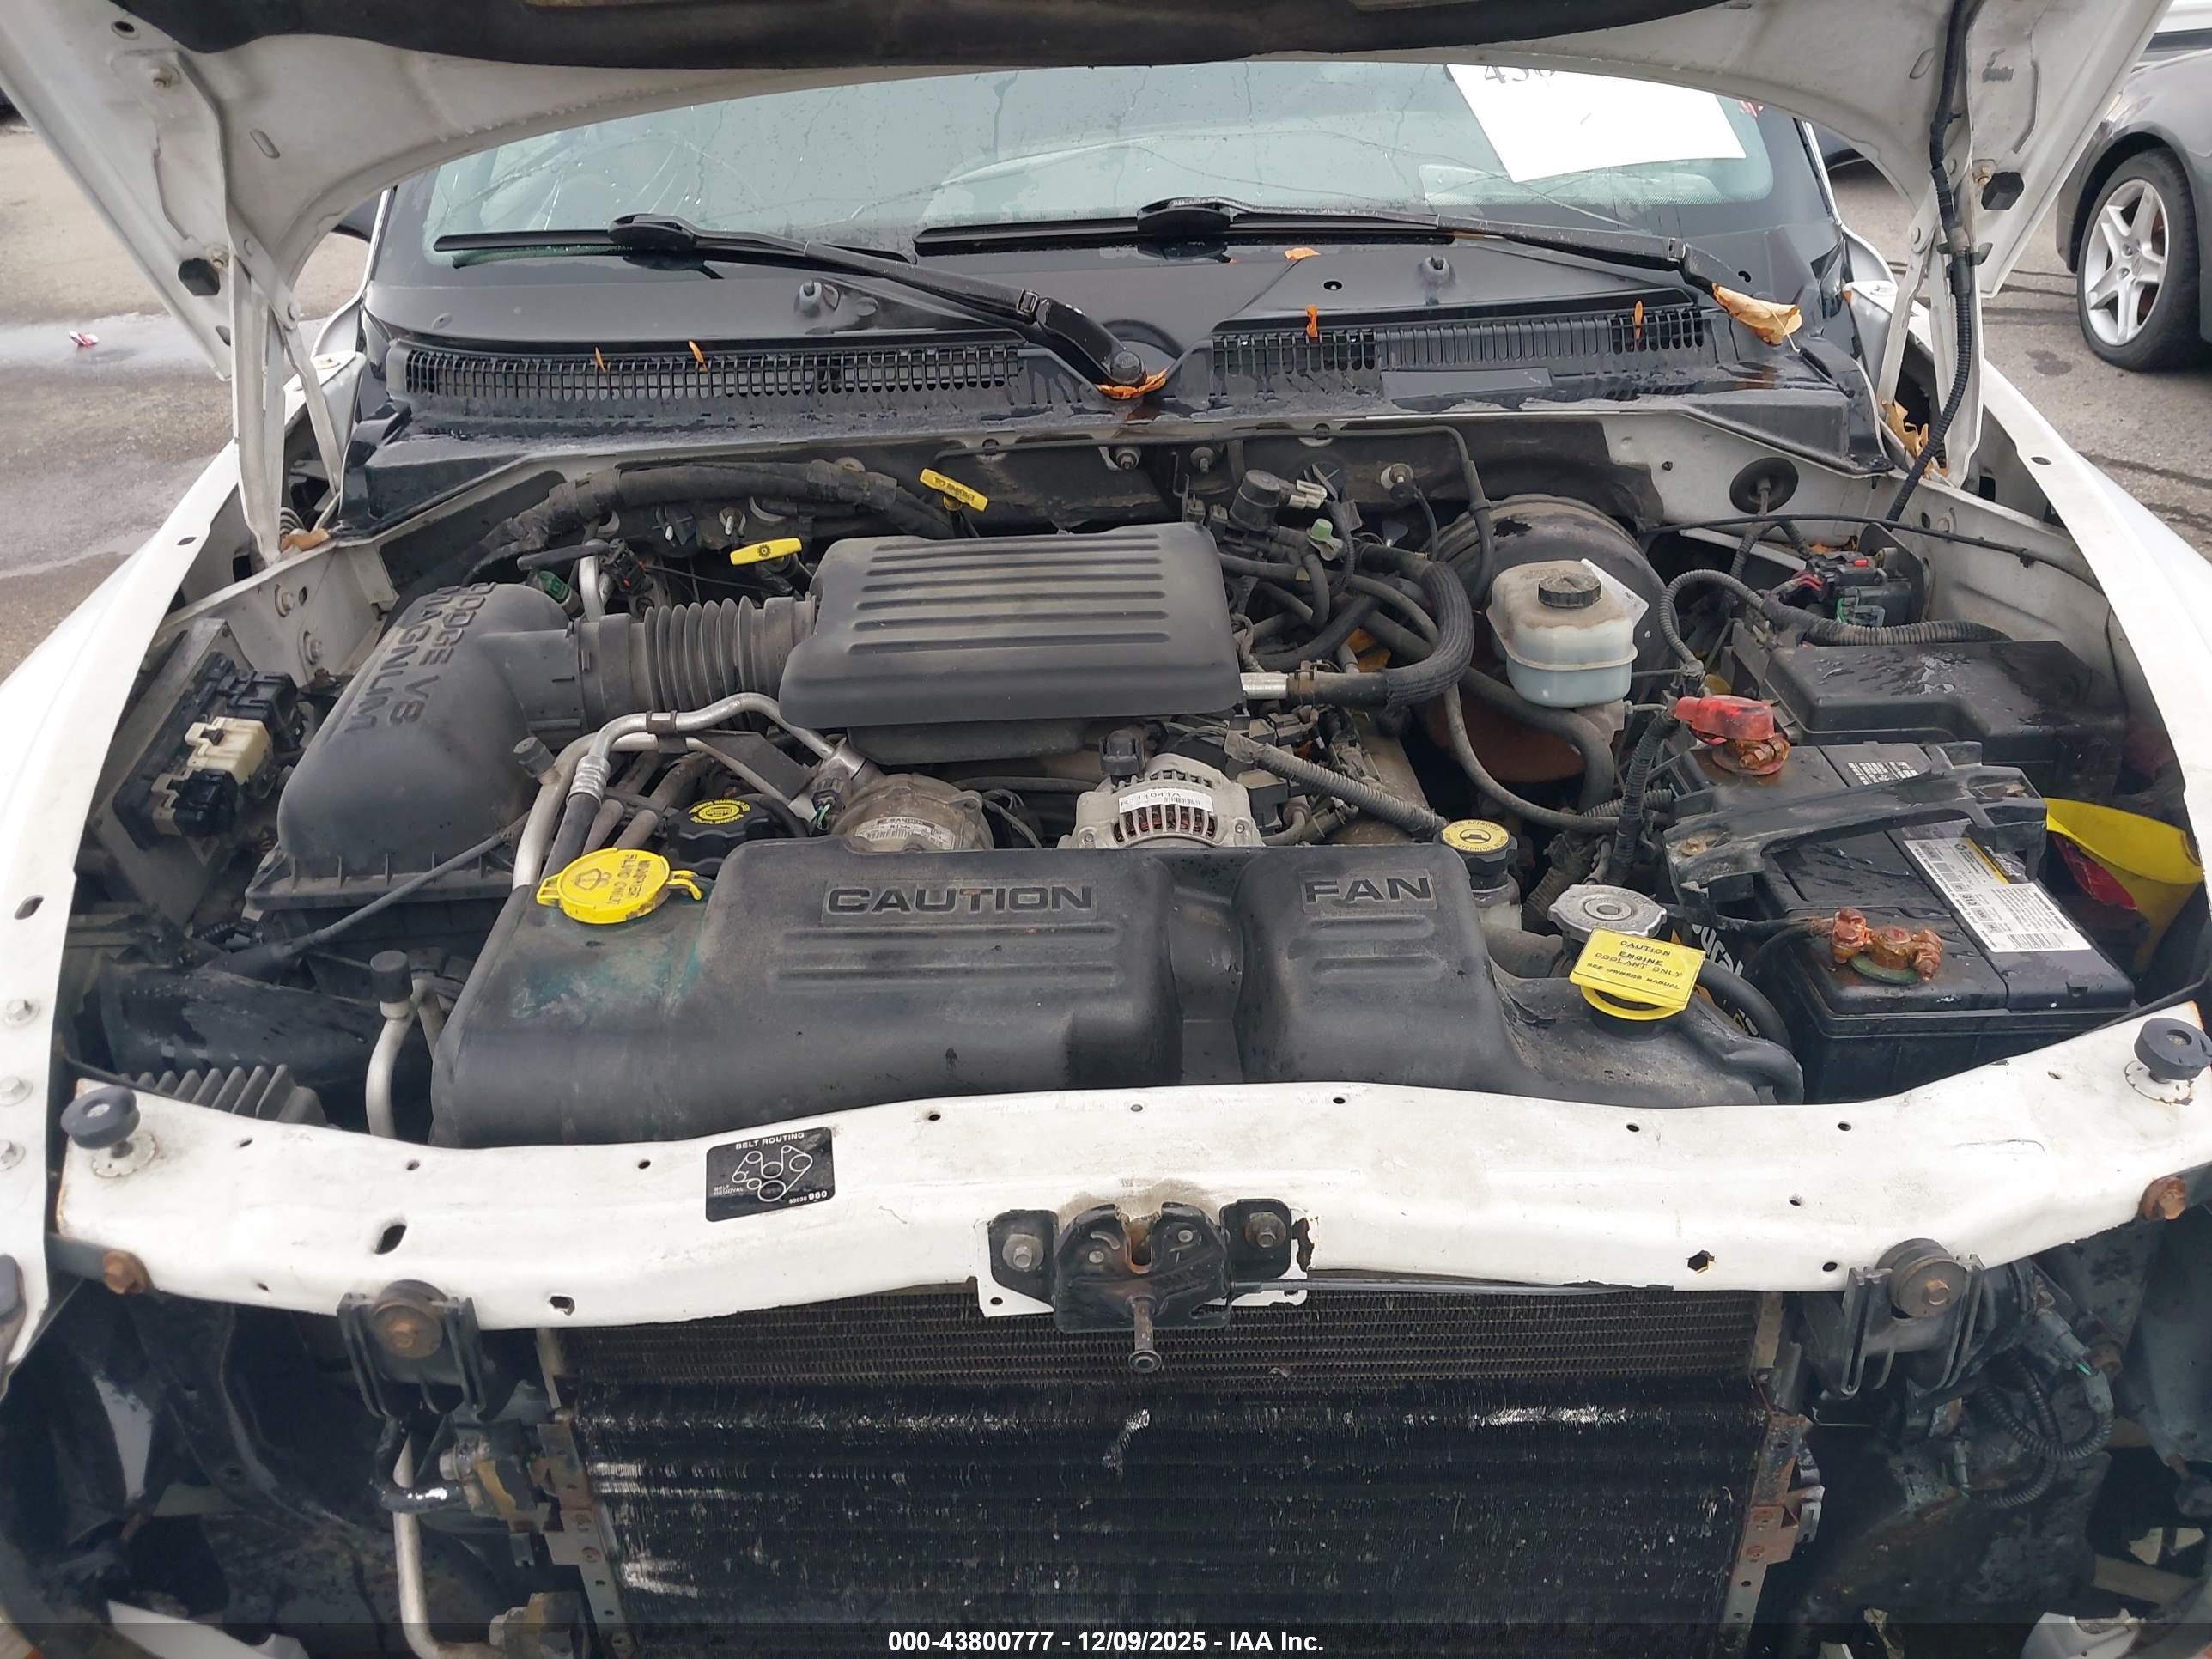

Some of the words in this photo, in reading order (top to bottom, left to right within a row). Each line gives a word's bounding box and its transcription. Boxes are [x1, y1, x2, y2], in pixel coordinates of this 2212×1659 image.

[419, 582, 497, 666] DODGE
[345, 586, 461, 729] MAGNUM
[390, 675, 440, 726] V8
[827, 885, 1093, 914] CAUTION
[1304, 876, 1434, 903] FAN
[1619, 951, 1663, 966] ENGINE
[1620, 940, 1671, 957] CAUTION
[1587, 963, 1604, 971] SEE
[1646, 977, 1680, 990] MANUAL
[1595, 952, 1649, 969] COOLANT
[1652, 967, 1683, 978] ONLY
[735, 1139, 759, 1151] BELT
[762, 1132, 805, 1146] ROUTING
[714, 1188, 744, 1196] REMOVAL
